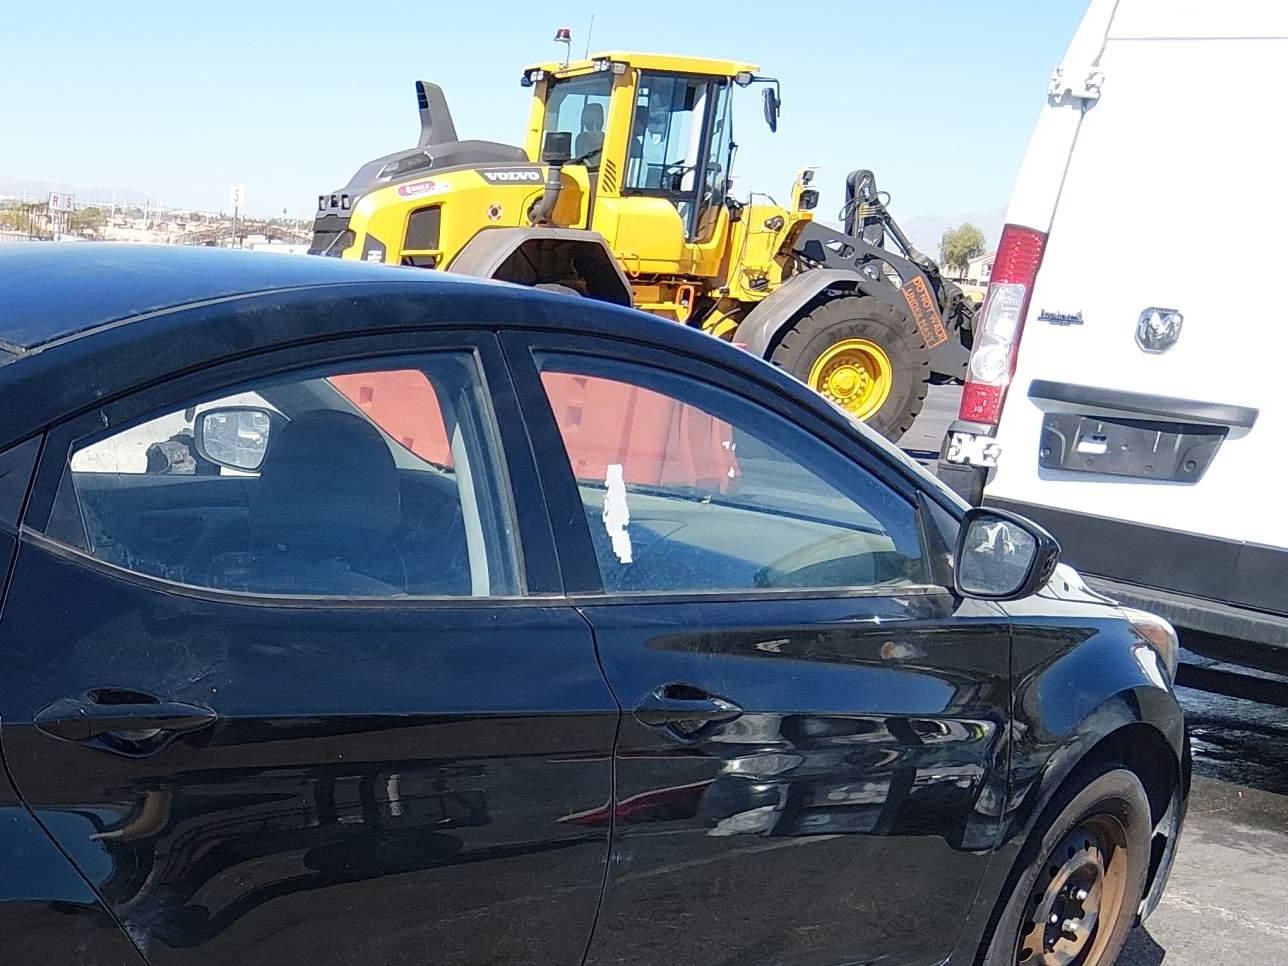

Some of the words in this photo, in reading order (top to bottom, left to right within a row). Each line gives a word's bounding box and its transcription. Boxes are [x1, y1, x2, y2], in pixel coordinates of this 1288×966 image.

[483, 171, 540, 181] VOLVO
[913, 278, 924, 293] DO
[920, 293, 933, 312] NOT
[930, 313, 946, 340] WALK
